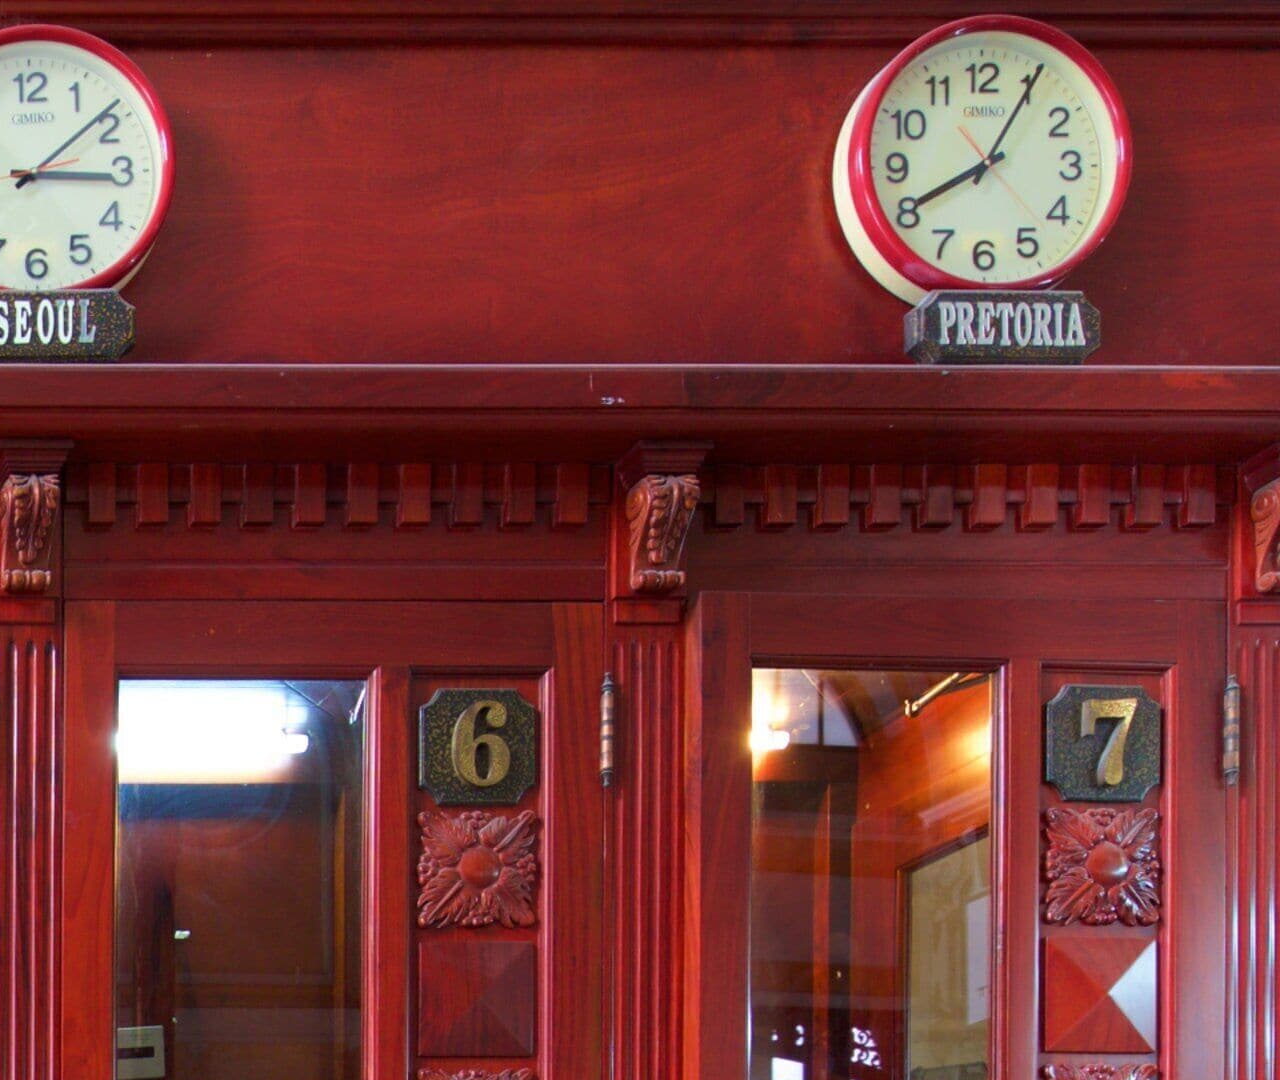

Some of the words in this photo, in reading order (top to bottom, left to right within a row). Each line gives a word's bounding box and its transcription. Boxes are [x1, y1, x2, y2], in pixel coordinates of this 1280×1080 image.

[13, 72, 48, 103] 12
[925, 76, 950, 106] 11
[966, 63, 999, 94] 12
[69, 82, 80, 112] 1
[963, 106, 1005, 117] GIMIKO
[11, 112, 54, 124] GIMIKO
[99, 113, 120, 143] 2
[891, 109, 926, 140] 10
[1048, 107, 1070, 137] 2
[112, 156, 134, 186] 3
[886, 152, 909, 183] 9
[1059, 151, 1082, 181] 3
[99, 201, 123, 230] 4
[897, 197, 920, 229] 8
[1046, 195, 1070, 225] 4
[70, 234, 92, 265] 5
[932, 229, 955, 259] 7
[972, 241, 995, 271] 6
[1017, 228, 1039, 258] 5
[25, 248, 48, 279] 6
[938, 302, 1086, 346] PRETORIA
[450, 698, 511, 787] 6
[1080, 697, 1138, 787] 7
